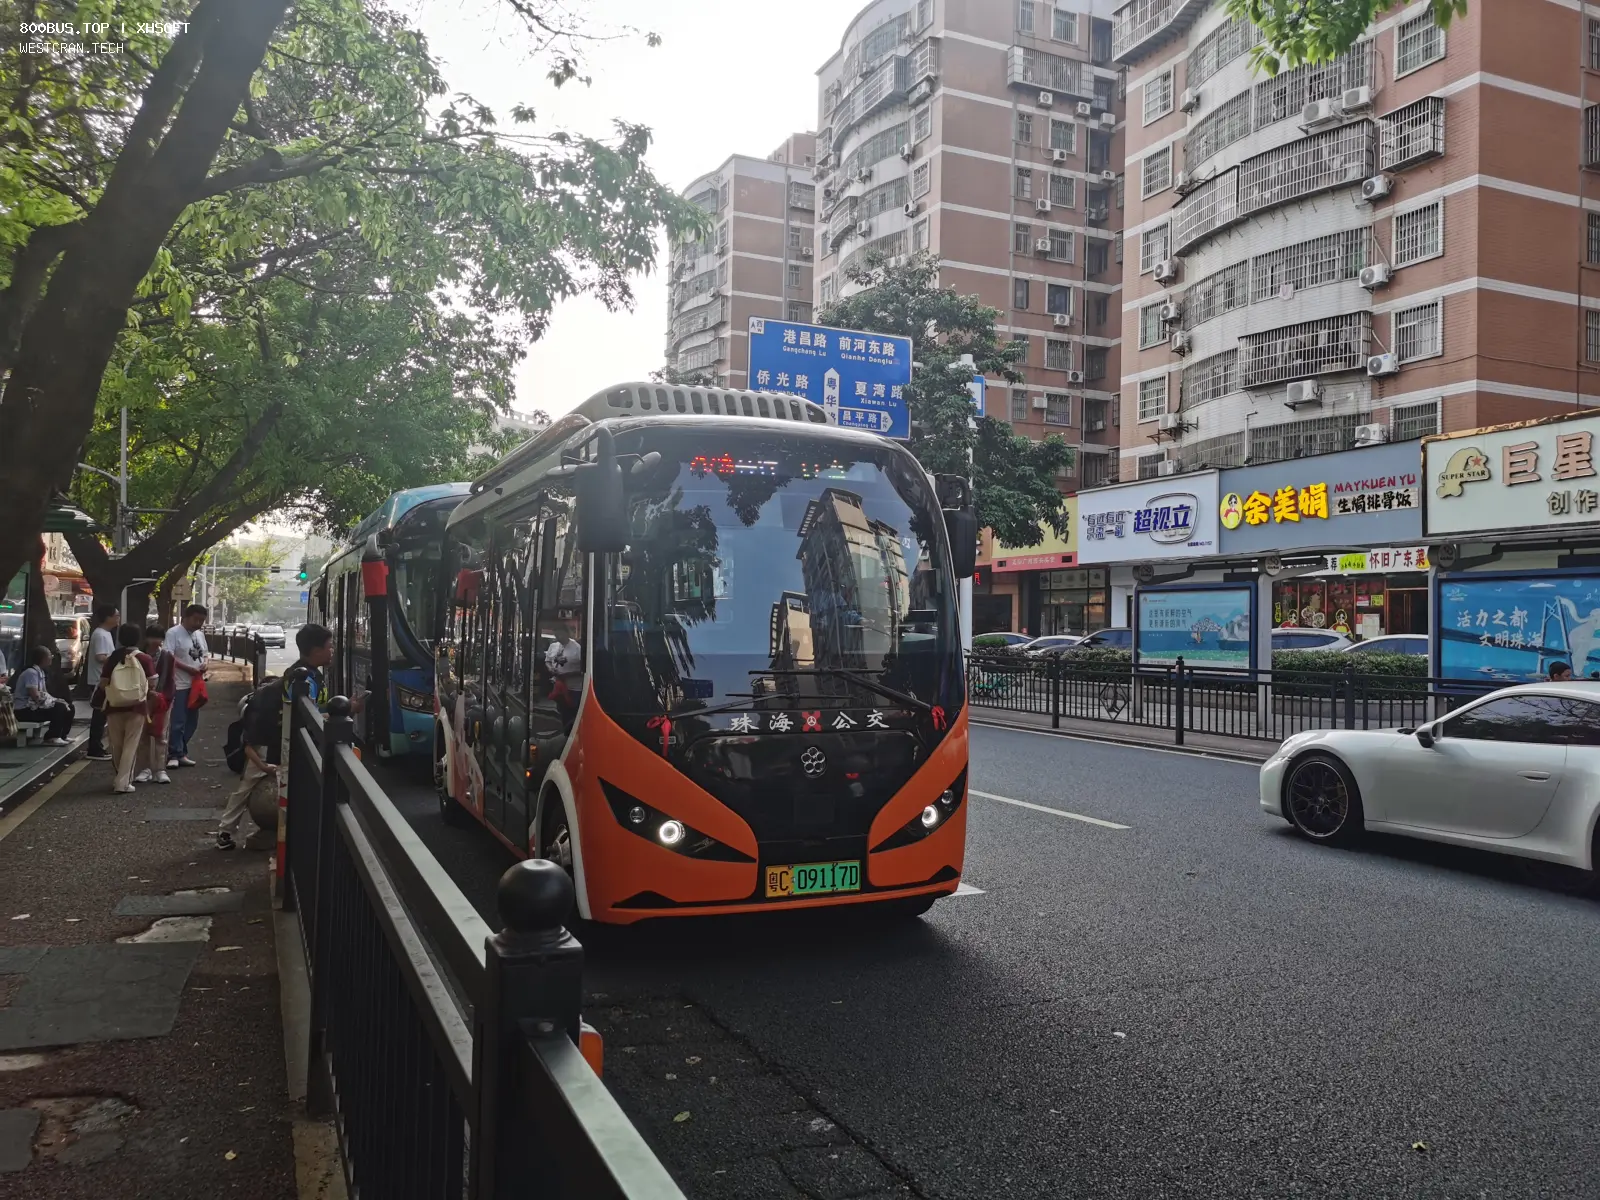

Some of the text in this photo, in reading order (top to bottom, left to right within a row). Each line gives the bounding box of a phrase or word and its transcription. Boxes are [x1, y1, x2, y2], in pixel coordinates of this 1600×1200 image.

[783, 329, 895, 357] 港昌路 前河东路
[783, 345, 816, 356] Gangchang
[841, 352, 893, 365] Qianhe Donglu
[757, 370, 809, 390] 侨光路
[855, 381, 904, 400] 夏湾路
[861, 397, 885, 406] Xiawan
[843, 410, 878, 424] 昌平路
[1501, 431, 1597, 487] 巨星
[1334, 473, 1417, 494] MAYKUEN YU
[1441, 470, 1486, 481] SUPER STAR
[1243, 482, 1329, 525] 余美娟
[1338, 489, 1412, 513] 生焗排骨饭
[1547, 490, 1598, 515] 创作
[1133, 504, 1191, 534] 超视立
[1369, 548, 1425, 569] 怀旧广东菜
[1457, 605, 1528, 630] 活力之都
[1479, 630, 1544, 649] 文明珠海
[730, 709, 891, 734] 珠海 公交
[768, 863, 860, 893] 粤C 09117D
